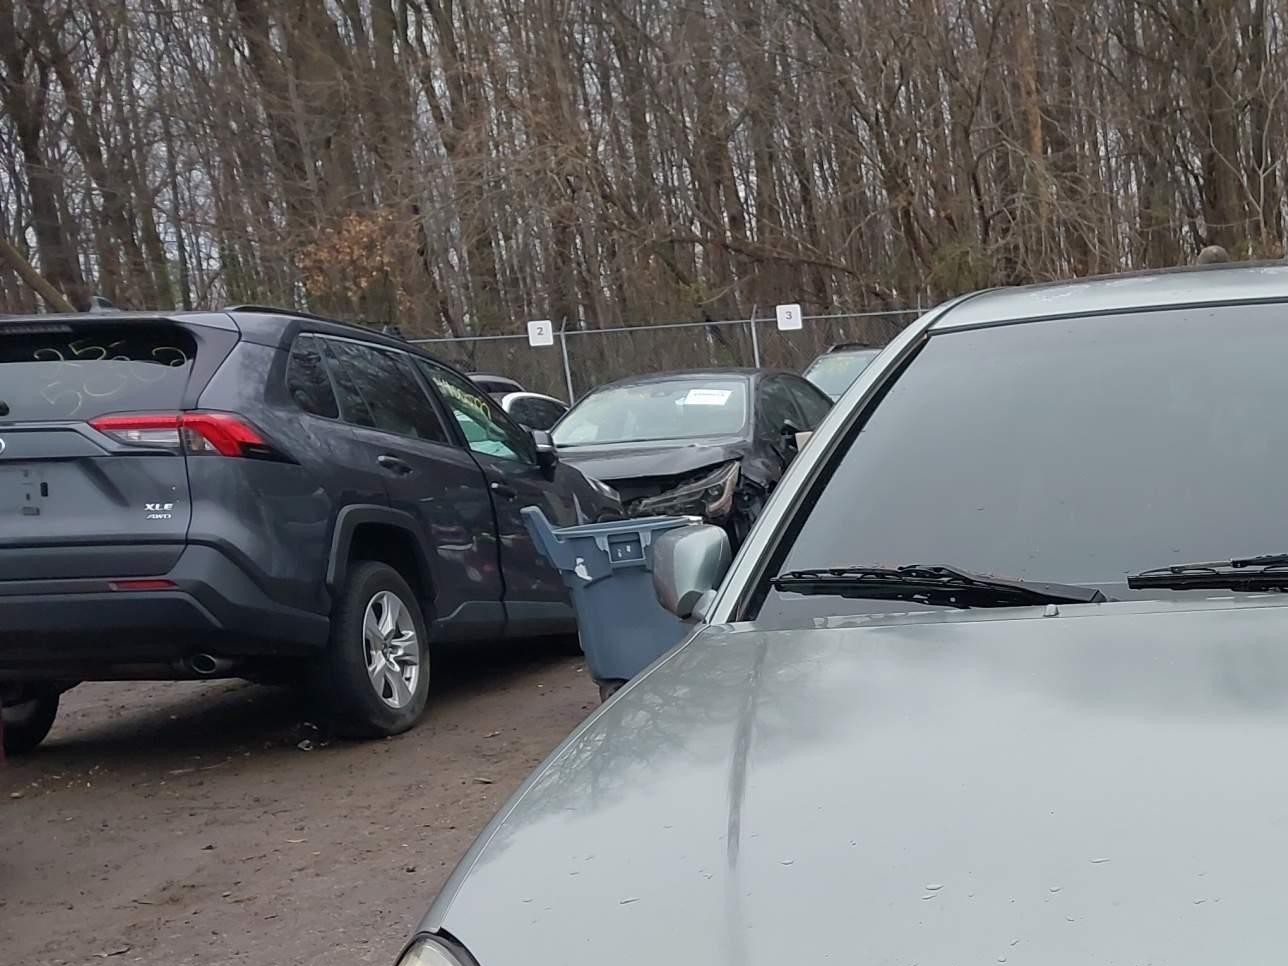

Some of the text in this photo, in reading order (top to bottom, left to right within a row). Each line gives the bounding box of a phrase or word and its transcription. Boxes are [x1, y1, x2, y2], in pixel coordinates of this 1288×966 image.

[785, 310, 793, 320] 3
[536, 326, 544, 336] 2
[144, 503, 174, 511] XLE
